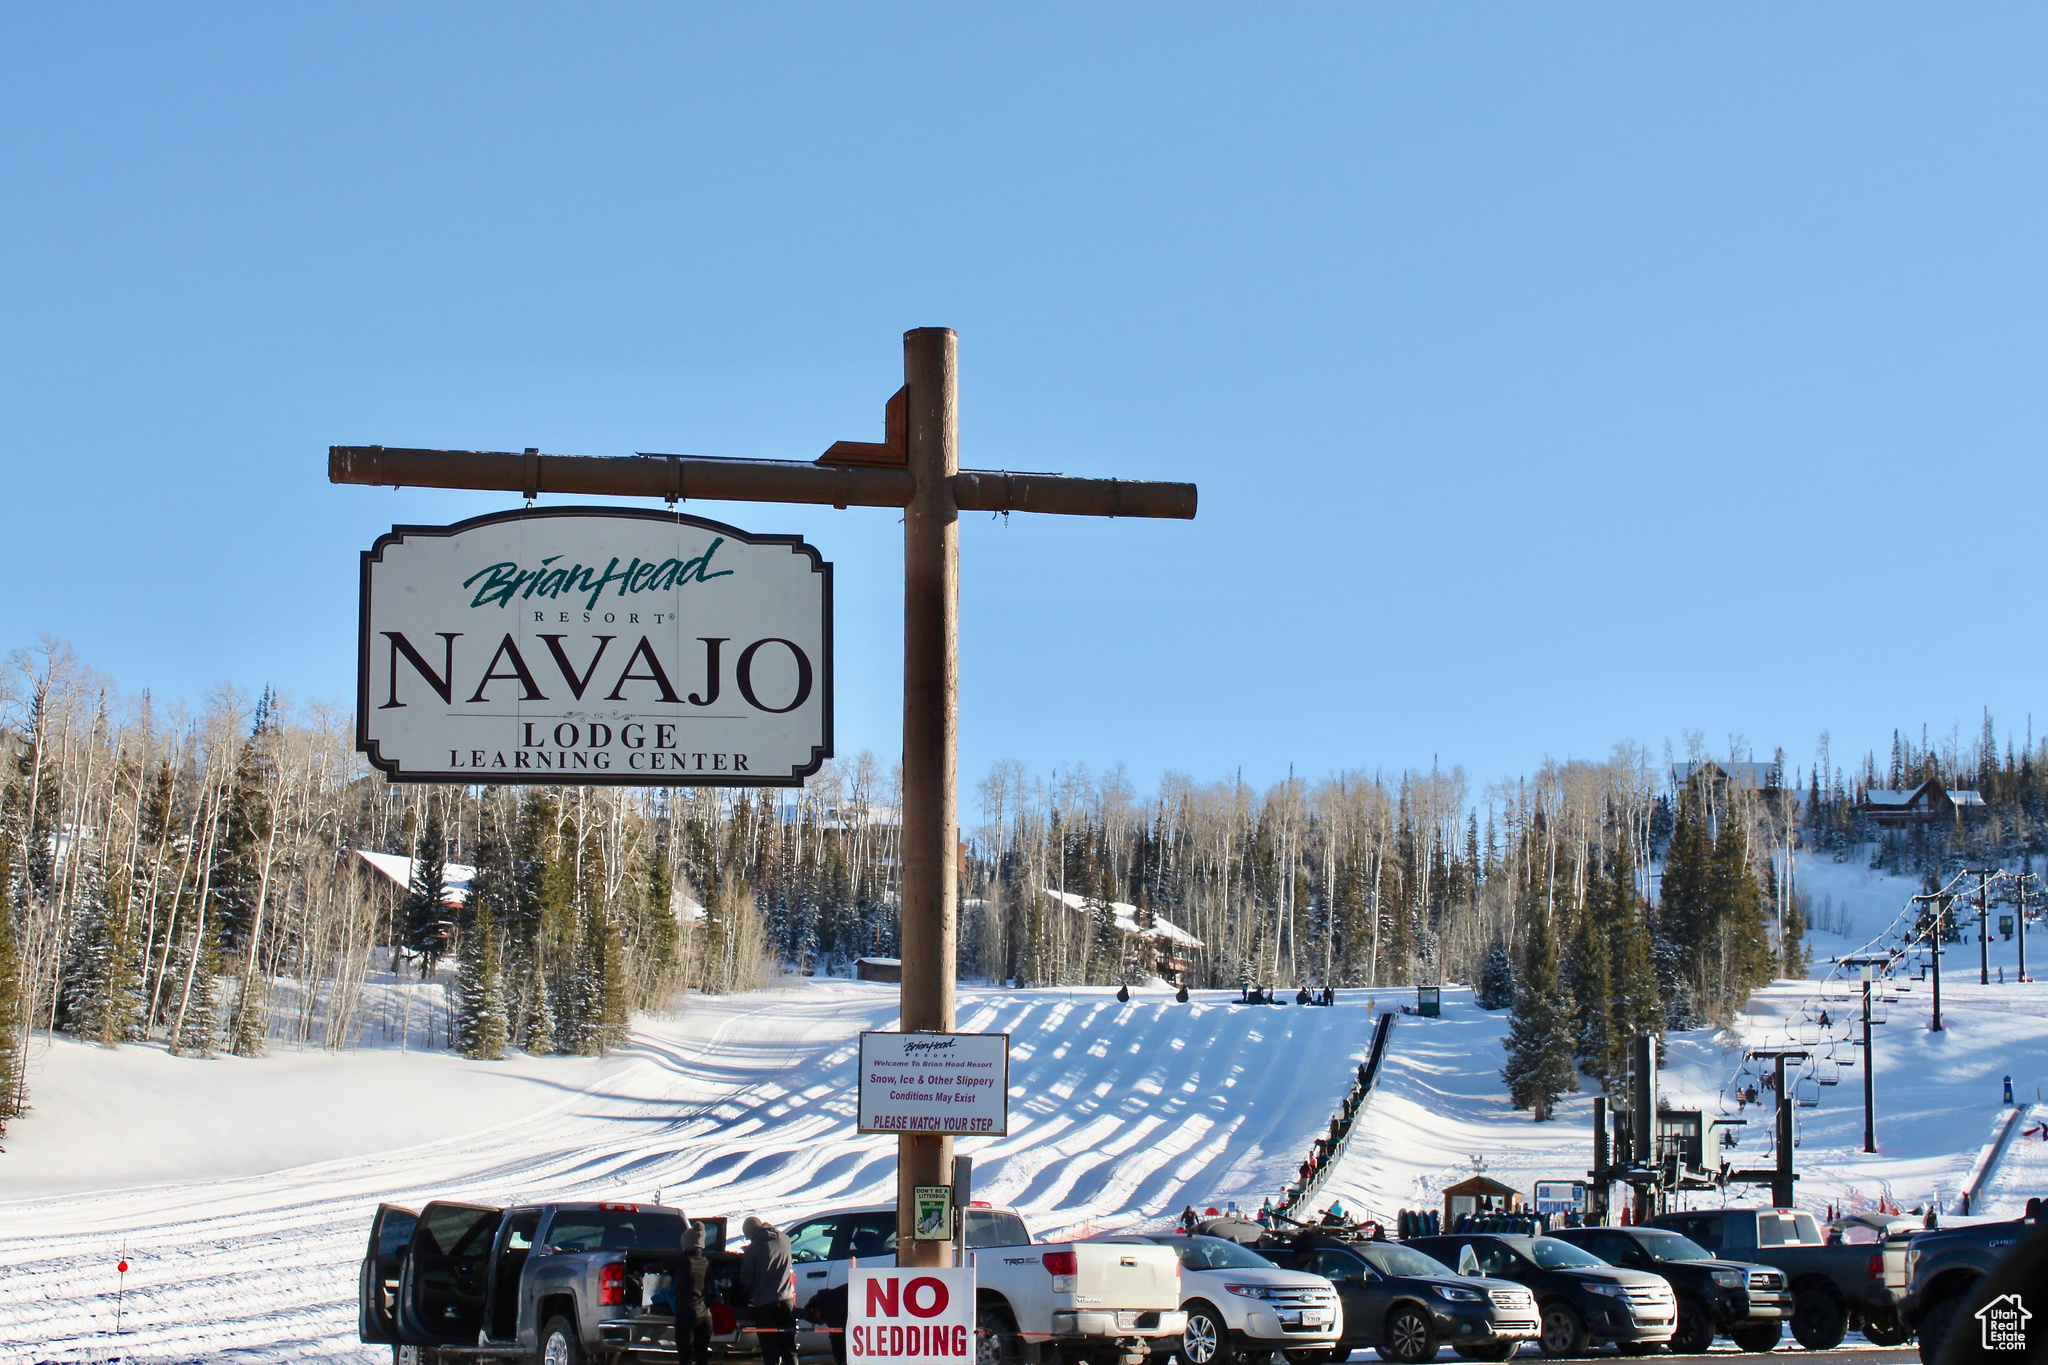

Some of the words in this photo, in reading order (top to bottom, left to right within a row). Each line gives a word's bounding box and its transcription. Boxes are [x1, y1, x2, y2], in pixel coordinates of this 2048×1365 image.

[377, 631, 813, 714] NAVAJO
[522, 722, 679, 750] LODGE
[449, 749, 613, 770] LEARNING
[628, 752, 750, 772] CENTER
[922, 1060, 943, 1068] Brian
[870, 1073, 897, 1086] Snow,
[900, 1074, 915, 1084] Ice
[917, 1074, 925, 1084] &
[927, 1074, 954, 1085] Other
[956, 1075, 994, 1088] Slippery
[889, 1090, 933, 1101] Conditions
[935, 1092, 952, 1104] May
[954, 1092, 976, 1103] Exist
[873, 1115, 908, 1129] PLEASE
[909, 1116, 941, 1130] WATCH
[944, 1117, 968, 1131] YOUR
[970, 1117, 993, 1132] STEP
[866, 1276, 950, 1318] NO
[852, 1324, 967, 1357] SLEDDING
